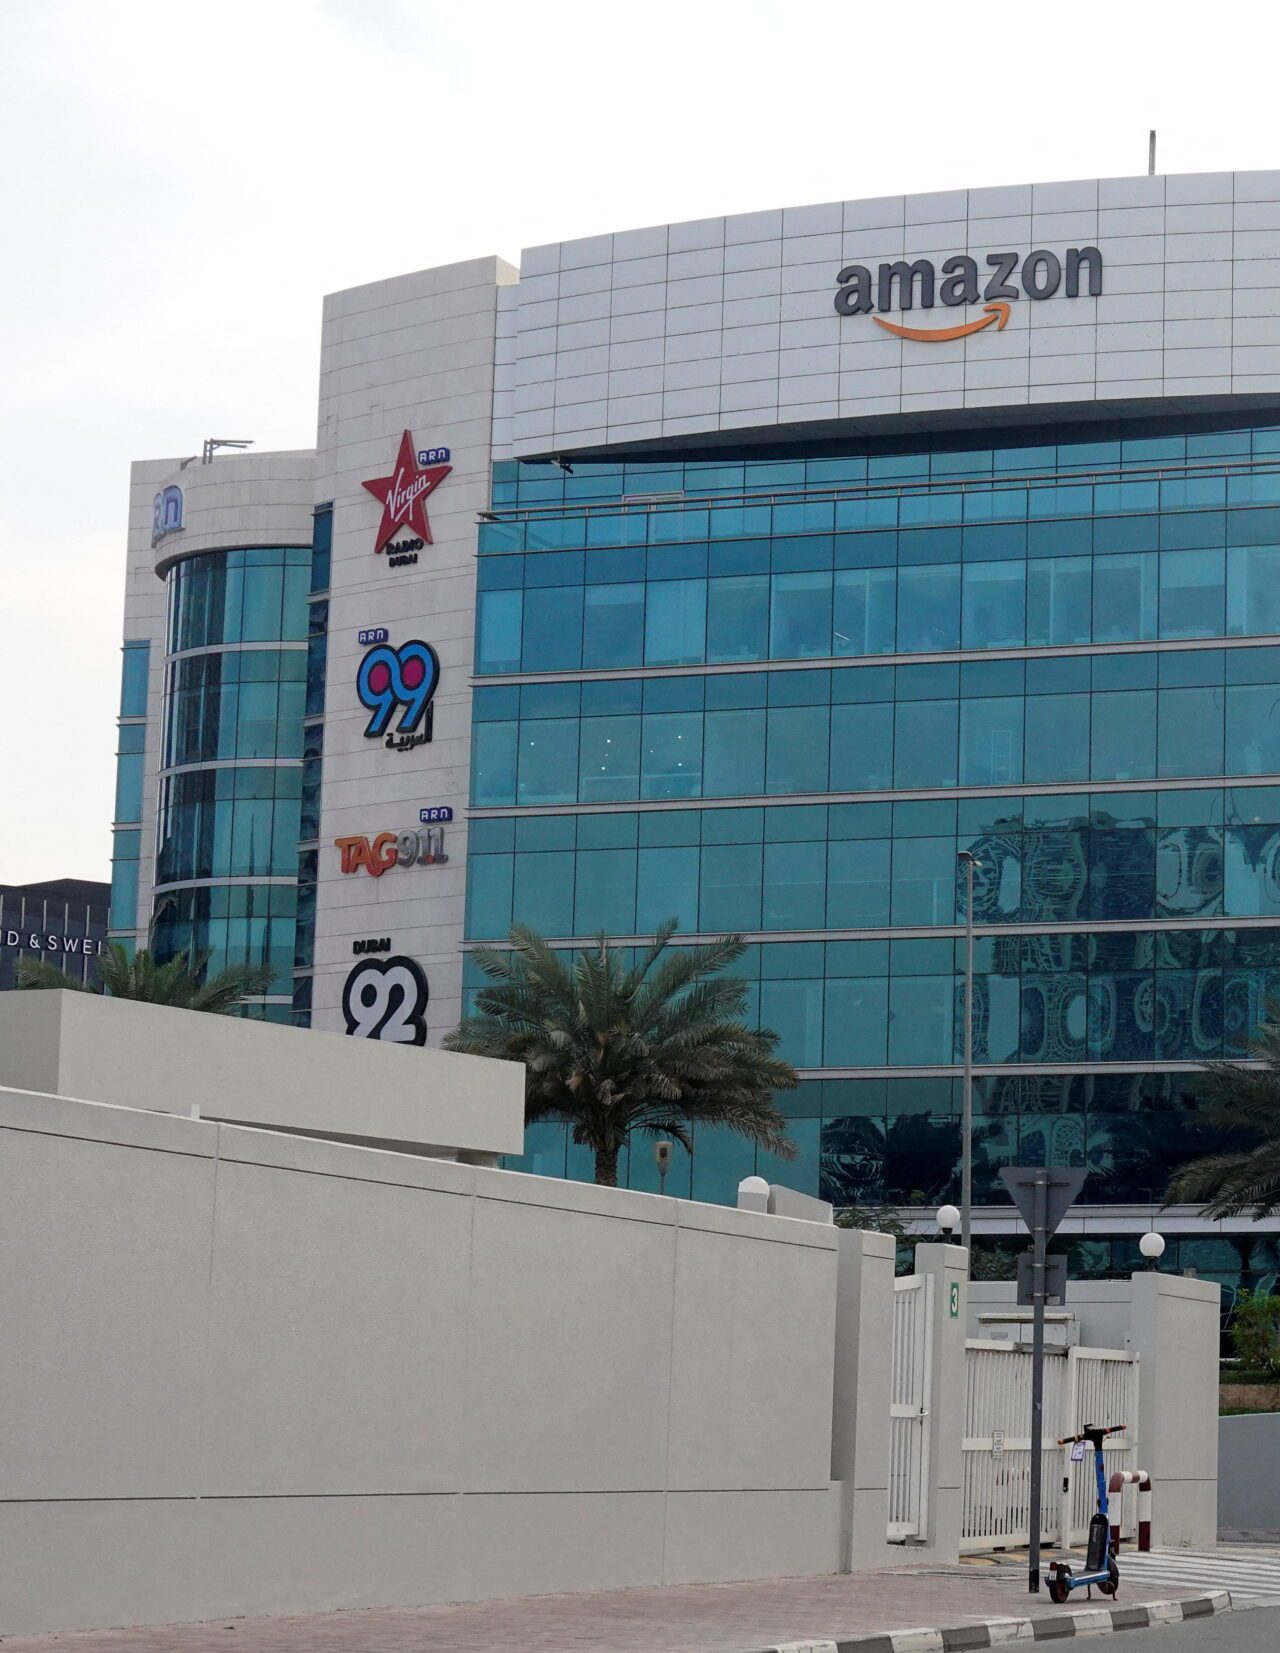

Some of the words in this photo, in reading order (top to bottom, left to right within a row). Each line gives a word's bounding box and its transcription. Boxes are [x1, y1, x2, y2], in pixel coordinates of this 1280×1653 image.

[834, 246, 1103, 316] amazon
[386, 467, 431, 522] Virgin
[386, 537, 425, 555] RADIO
[388, 553, 418, 567] DUBAI
[357, 639, 440, 738] 99
[29, 933, 41, 949] &
[352, 938, 391, 955] DUBAI
[345, 960, 424, 1044] 92
[951, 1287, 958, 1313] 3
